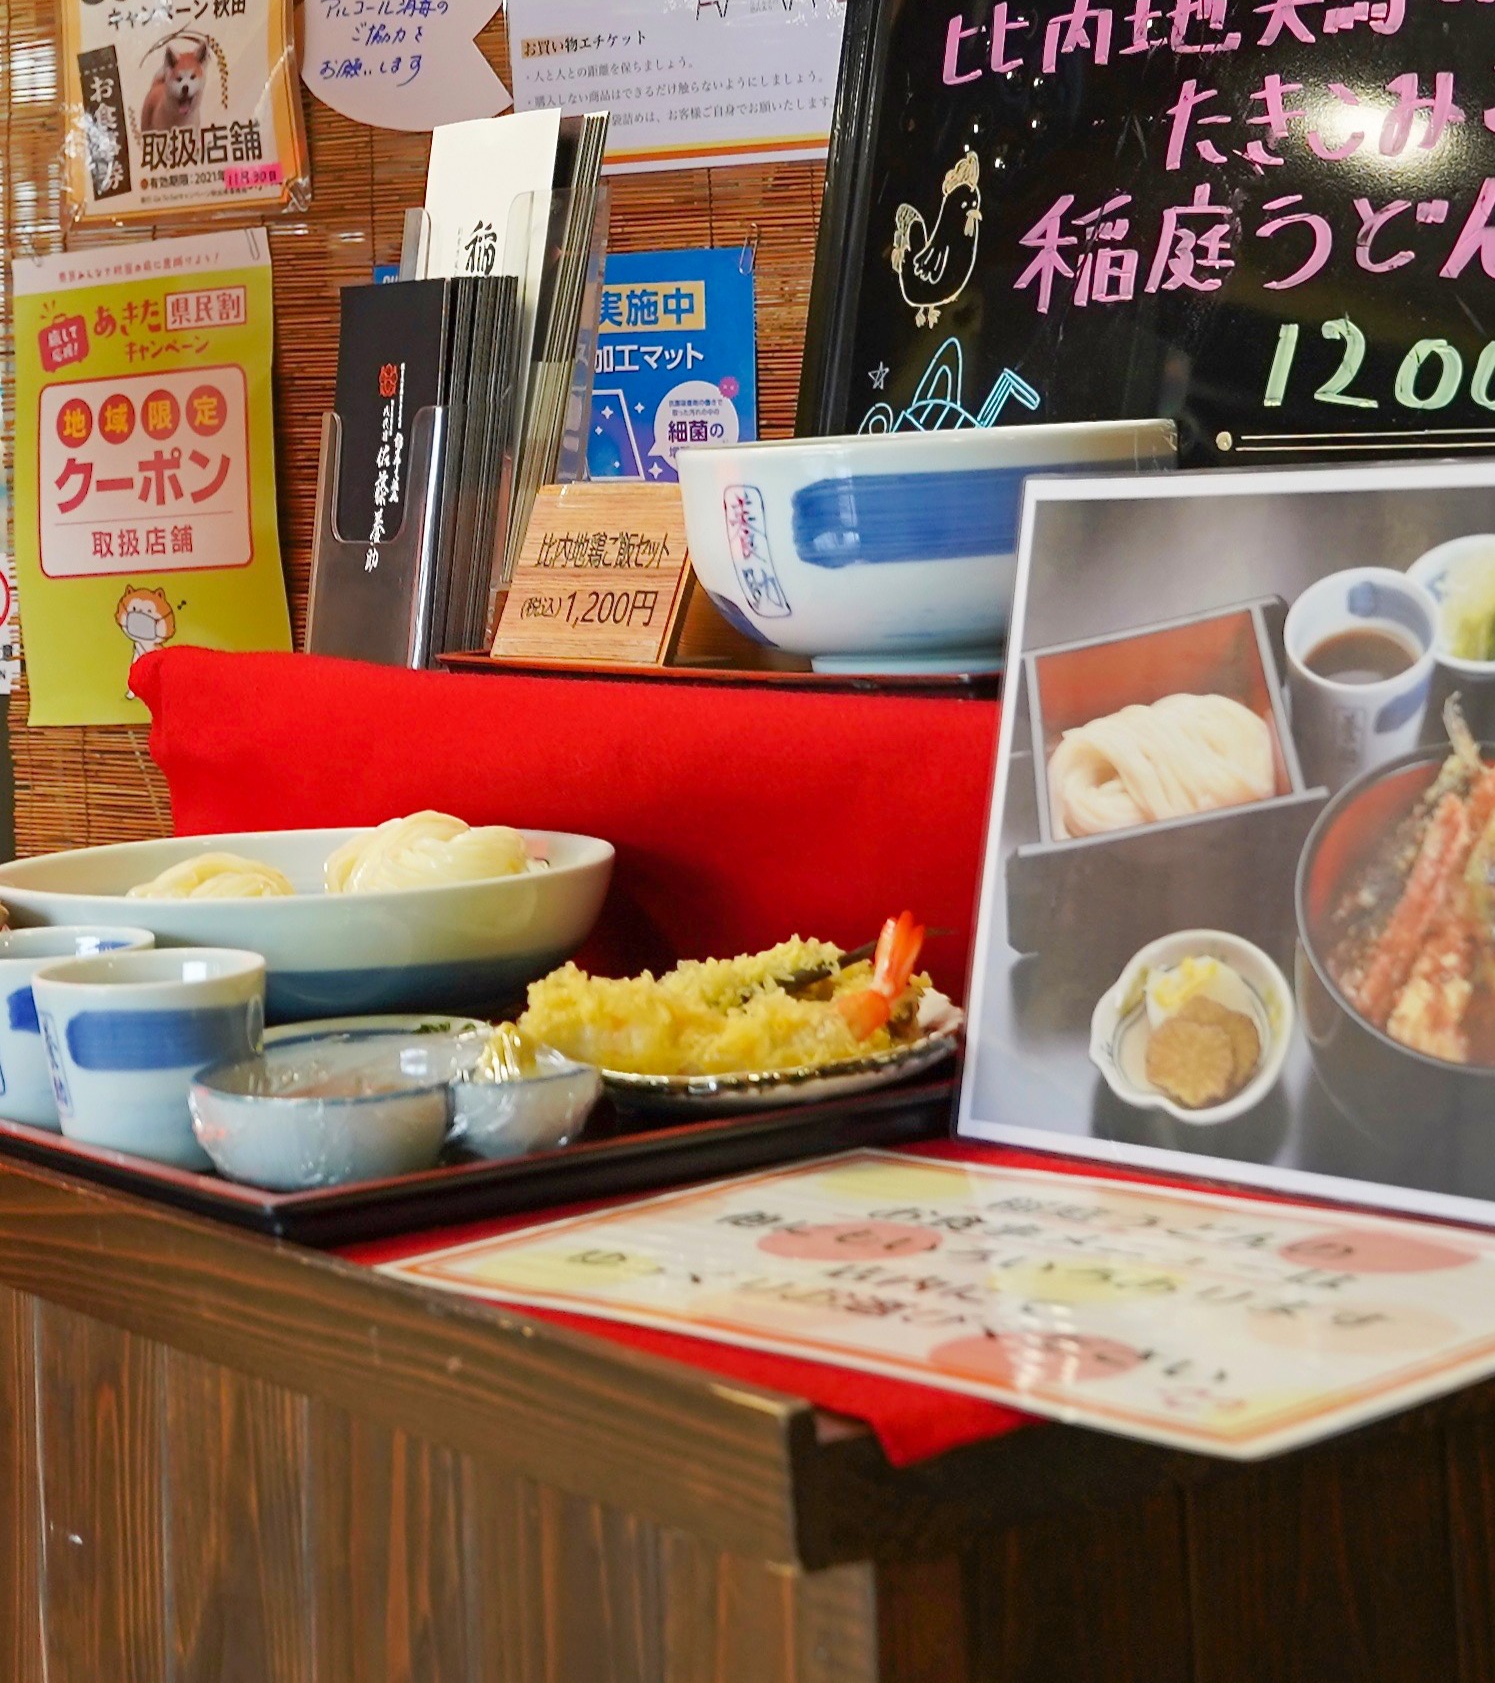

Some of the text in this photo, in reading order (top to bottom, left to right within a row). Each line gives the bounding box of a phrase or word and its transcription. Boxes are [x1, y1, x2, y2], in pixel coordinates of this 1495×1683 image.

[107, 0, 208, 31] キャンペーン
[351, 23, 425, 46] ご協力を
[522, 29, 646, 58] お買い物エチケット
[319, 54, 423, 88] お願いします
[140, 119, 263, 172] 取扱店舗
[228, 170, 278, 186] 11月30日
[464, 220, 498, 277] 稲
[599, 288, 695, 328] 実施中
[125, 336, 210, 363] キャンペーン
[595, 341, 704, 374] 加工マット
[62, 395, 222, 440] 地域限定
[668, 420, 724, 443] 細菌の
[54, 448, 232, 514] クーポン
[91, 525, 194, 559] 取扱店舗
[534, 530, 670, 571] 比内地鶏ご飯セット
[520, 589, 658, 627] (税込) 1,200円
